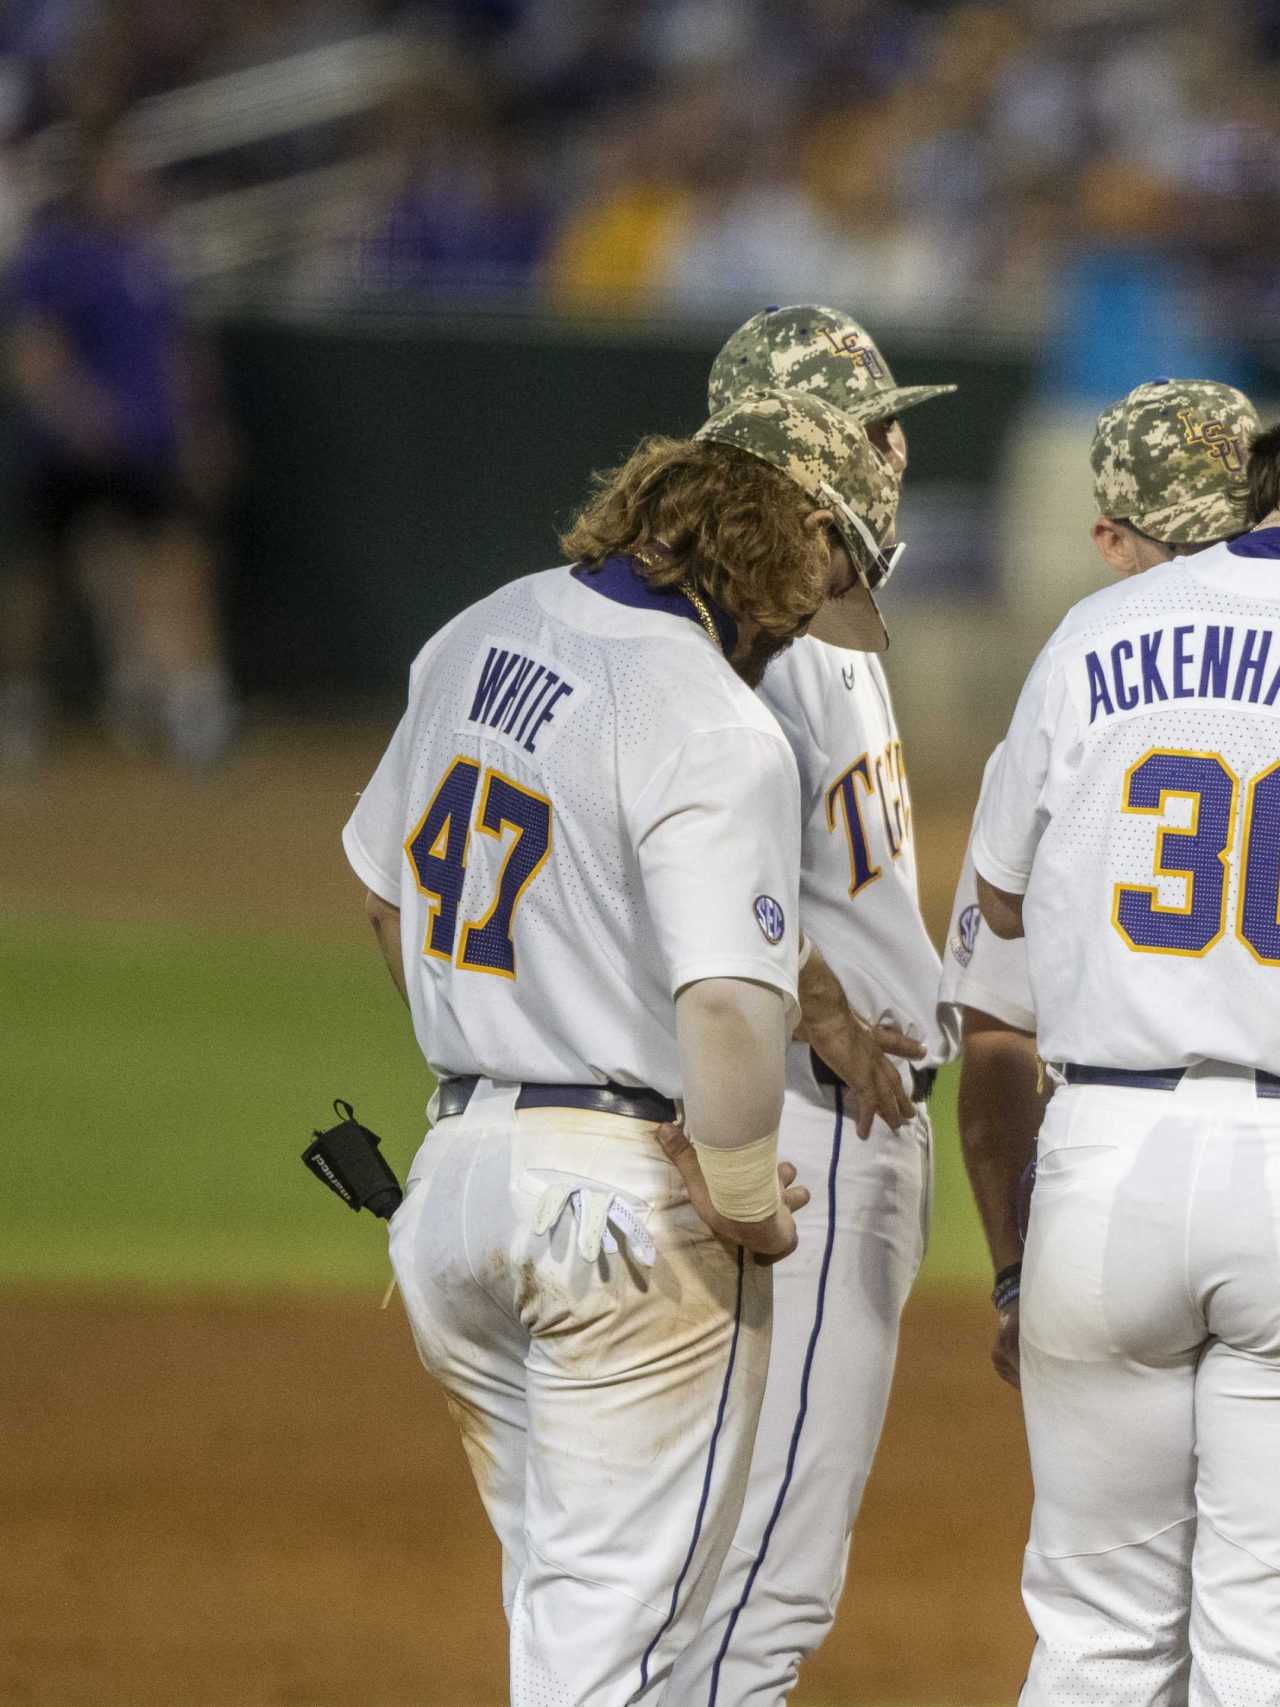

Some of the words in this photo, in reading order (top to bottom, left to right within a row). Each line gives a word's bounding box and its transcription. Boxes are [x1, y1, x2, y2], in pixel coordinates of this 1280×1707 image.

[1177, 408, 1246, 474] LSU
[468, 646, 574, 754] WHITE
[403, 753, 554, 982] 47
